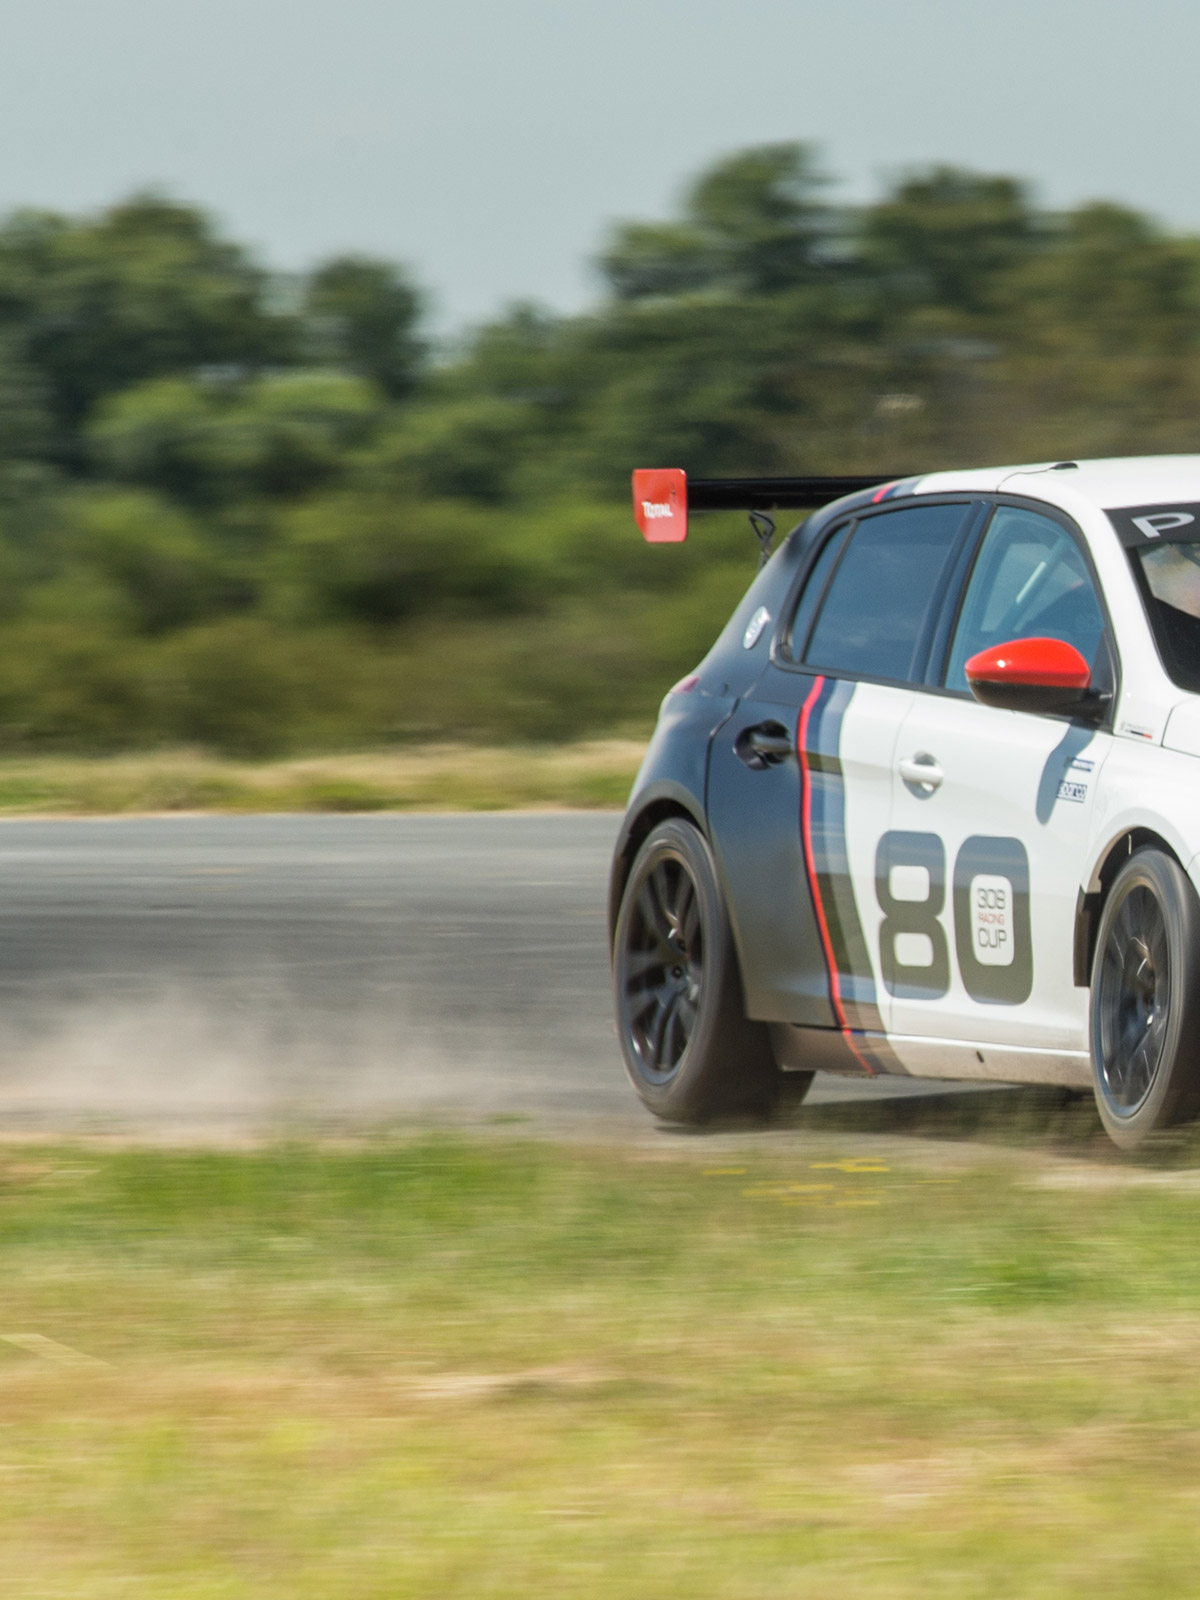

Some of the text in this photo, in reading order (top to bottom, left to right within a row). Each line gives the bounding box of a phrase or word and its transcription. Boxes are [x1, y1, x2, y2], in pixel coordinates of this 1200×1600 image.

[977, 888, 1006, 910] 308
[875, 830, 1033, 1006] 80
[978, 928, 1007, 950] CUP
